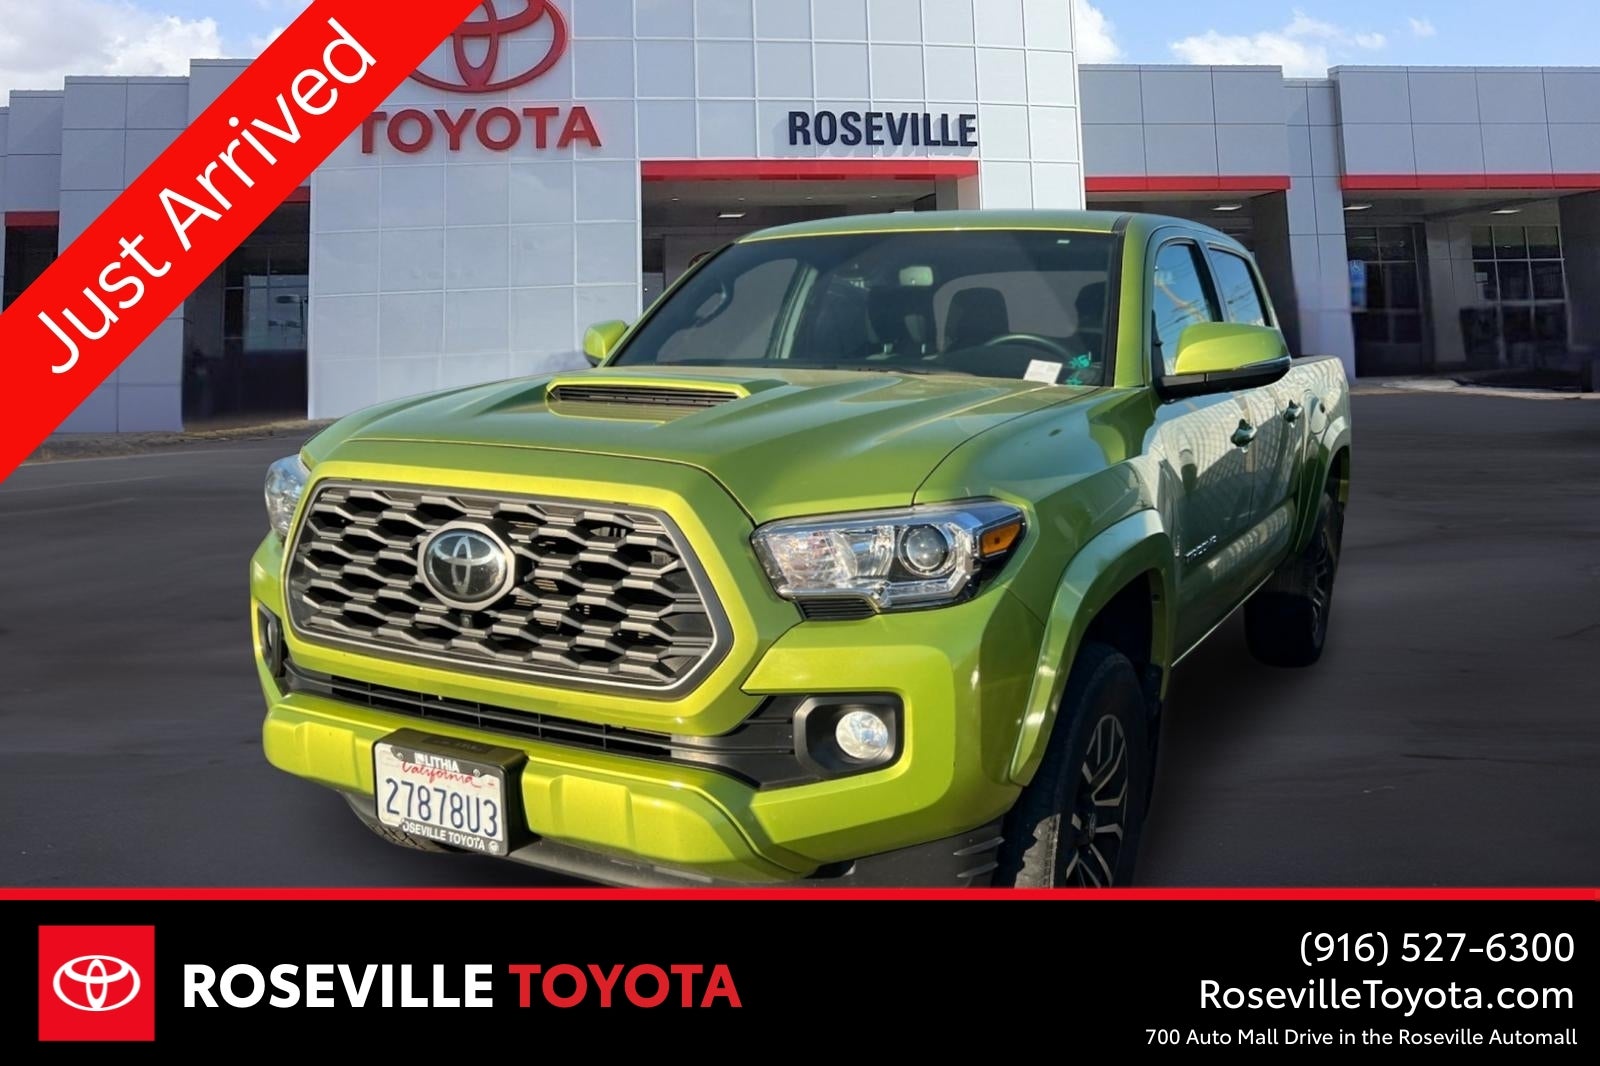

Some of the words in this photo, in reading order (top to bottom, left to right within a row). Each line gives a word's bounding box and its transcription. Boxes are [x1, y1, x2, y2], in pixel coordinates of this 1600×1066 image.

[361, 107, 601, 154] TOYOTA
[788, 111, 978, 147] ROSEVILLE
[424, 754, 460, 773] LITHIA
[385, 778, 498, 837] 27878U3
[448, 831, 485, 850] TOYOTA
